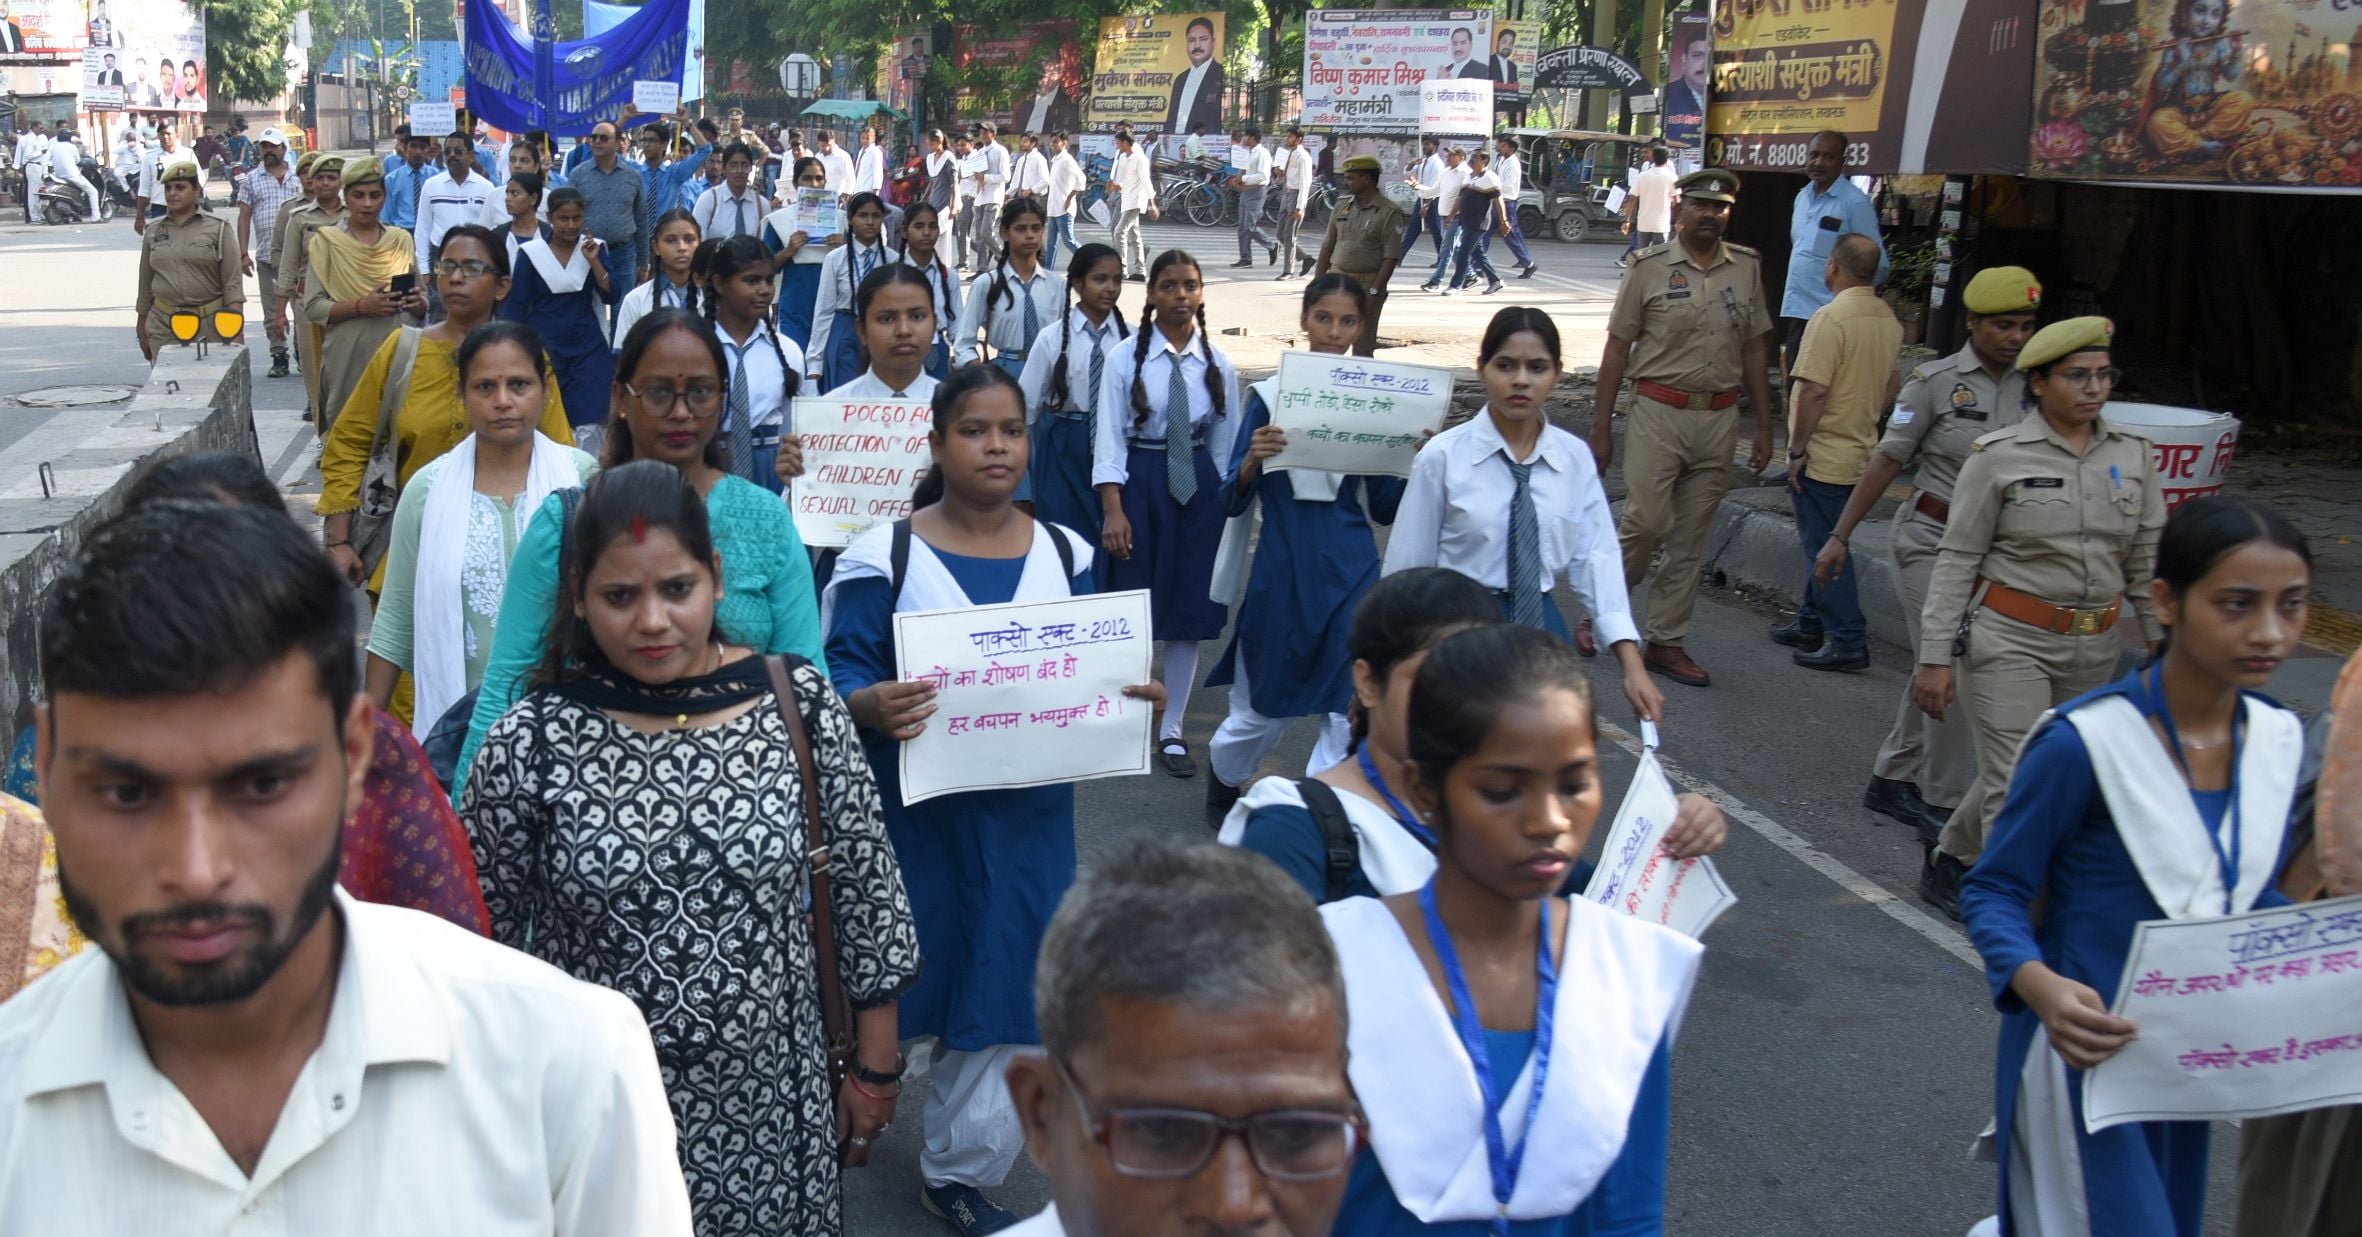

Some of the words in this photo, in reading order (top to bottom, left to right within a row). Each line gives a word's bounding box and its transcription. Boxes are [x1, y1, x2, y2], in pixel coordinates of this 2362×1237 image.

[1775, 25, 1812, 41] एडवोकेट
[1094, 68, 1129, 91] मुकेश
[1133, 68, 1173, 87] सोनकर
[1310, 62, 1344, 95] विष्णु
[1347, 68, 1391, 95] कुमार
[1713, 50, 1776, 93] प्रत्याशी
[1779, 50, 1834, 100] संयुक्त
[1834, 42, 1874, 88] मंत्री
[1094, 97, 1122, 110] प्रत्याशी
[1124, 96, 1147, 112] संयुक्त
[1149, 96, 1164, 110] मंत्री
[1334, 94, 1393, 115] महामंत्री
[1759, 108, 1770, 120] बार
[1816, 106, 1846, 119] लखनऊ
[1726, 136, 1744, 165] मो.
[1749, 143, 1763, 165] न.
[1768, 143, 1869, 167] 880833
[842, 404, 906, 424] POCSO
[909, 406, 934, 424] AC
[800, 433, 893, 453] PROTECTION
[905, 436, 929, 454] OF
[2152, 443, 2204, 479] गर
[817, 465, 904, 487] CHILDREN
[800, 496, 859, 516] SEXUAL
[868, 499, 912, 518] OFFE
[1090, 617, 1131, 639] 2012
[954, 669, 976, 687] का
[982, 661, 1030, 686] शोषण
[1037, 657, 1057, 681] बंद
[1062, 652, 1078, 678] हो
[948, 716, 969, 736] हर
[974, 712, 1022, 731] बचपन
[1030, 704, 1091, 728] भयमुक्त
[1095, 695, 1110, 717] हो
[952, 1199, 977, 1229] SPORT
